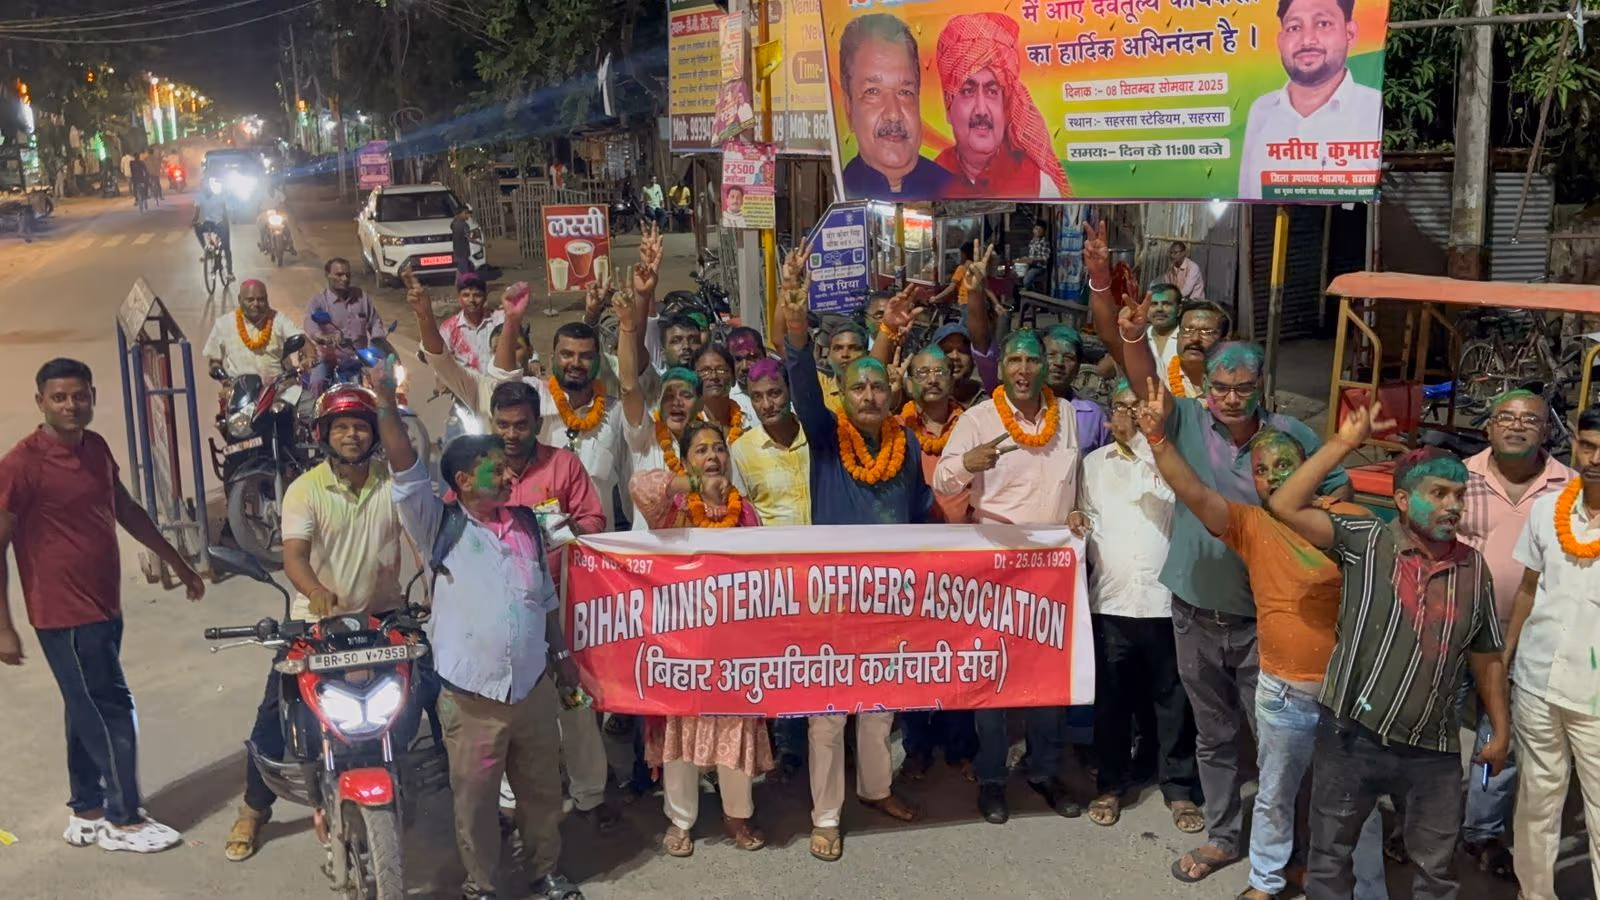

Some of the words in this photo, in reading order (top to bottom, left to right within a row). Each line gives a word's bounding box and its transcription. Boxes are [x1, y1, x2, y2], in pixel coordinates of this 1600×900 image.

[1023, 0, 1038, 22] में
[1046, 1, 1084, 23] आए
[1027, 44, 1051, 64] का
[1058, 32, 1115, 64] हार्दिक
[1124, 28, 1213, 57] अभिनंदन
[1218, 17, 1238, 52] है
[1106, 85, 1117, 96] 08
[1120, 80, 1155, 96] सितम्बर
[1158, 78, 1194, 93] सोमवार
[1198, 79, 1223, 92] 2025
[789, 112, 811, 139] Mob:
[1104, 115, 1137, 127] सहरसा
[1188, 112, 1224, 124] सहरसा
[1119, 144, 1144, 157] दिन
[1147, 143, 1162, 156] के
[1165, 144, 1195, 156] 11:00
[1198, 142, 1223, 155] बजे
[1266, 137, 1319, 160] मनीष
[1326, 140, 1380, 166] कुमार
[546, 207, 605, 237] लस्सी
[573, 550, 597, 572] Reg.
[626, 558, 653, 574] 3297
[1015, 551, 1071, 568] 25.05.1929
[572, 587, 645, 651] BIHAR
[652, 567, 800, 635] MINISTERIAL
[808, 565, 916, 617] OFFICERS
[920, 571, 1067, 650] ASSOCIATION
[634, 641, 714, 700] (बिहार
[717, 643, 855, 704] अनुसचिवीय
[860, 640, 953, 685] कर्मचारी
[957, 637, 1008, 694] संघ)
